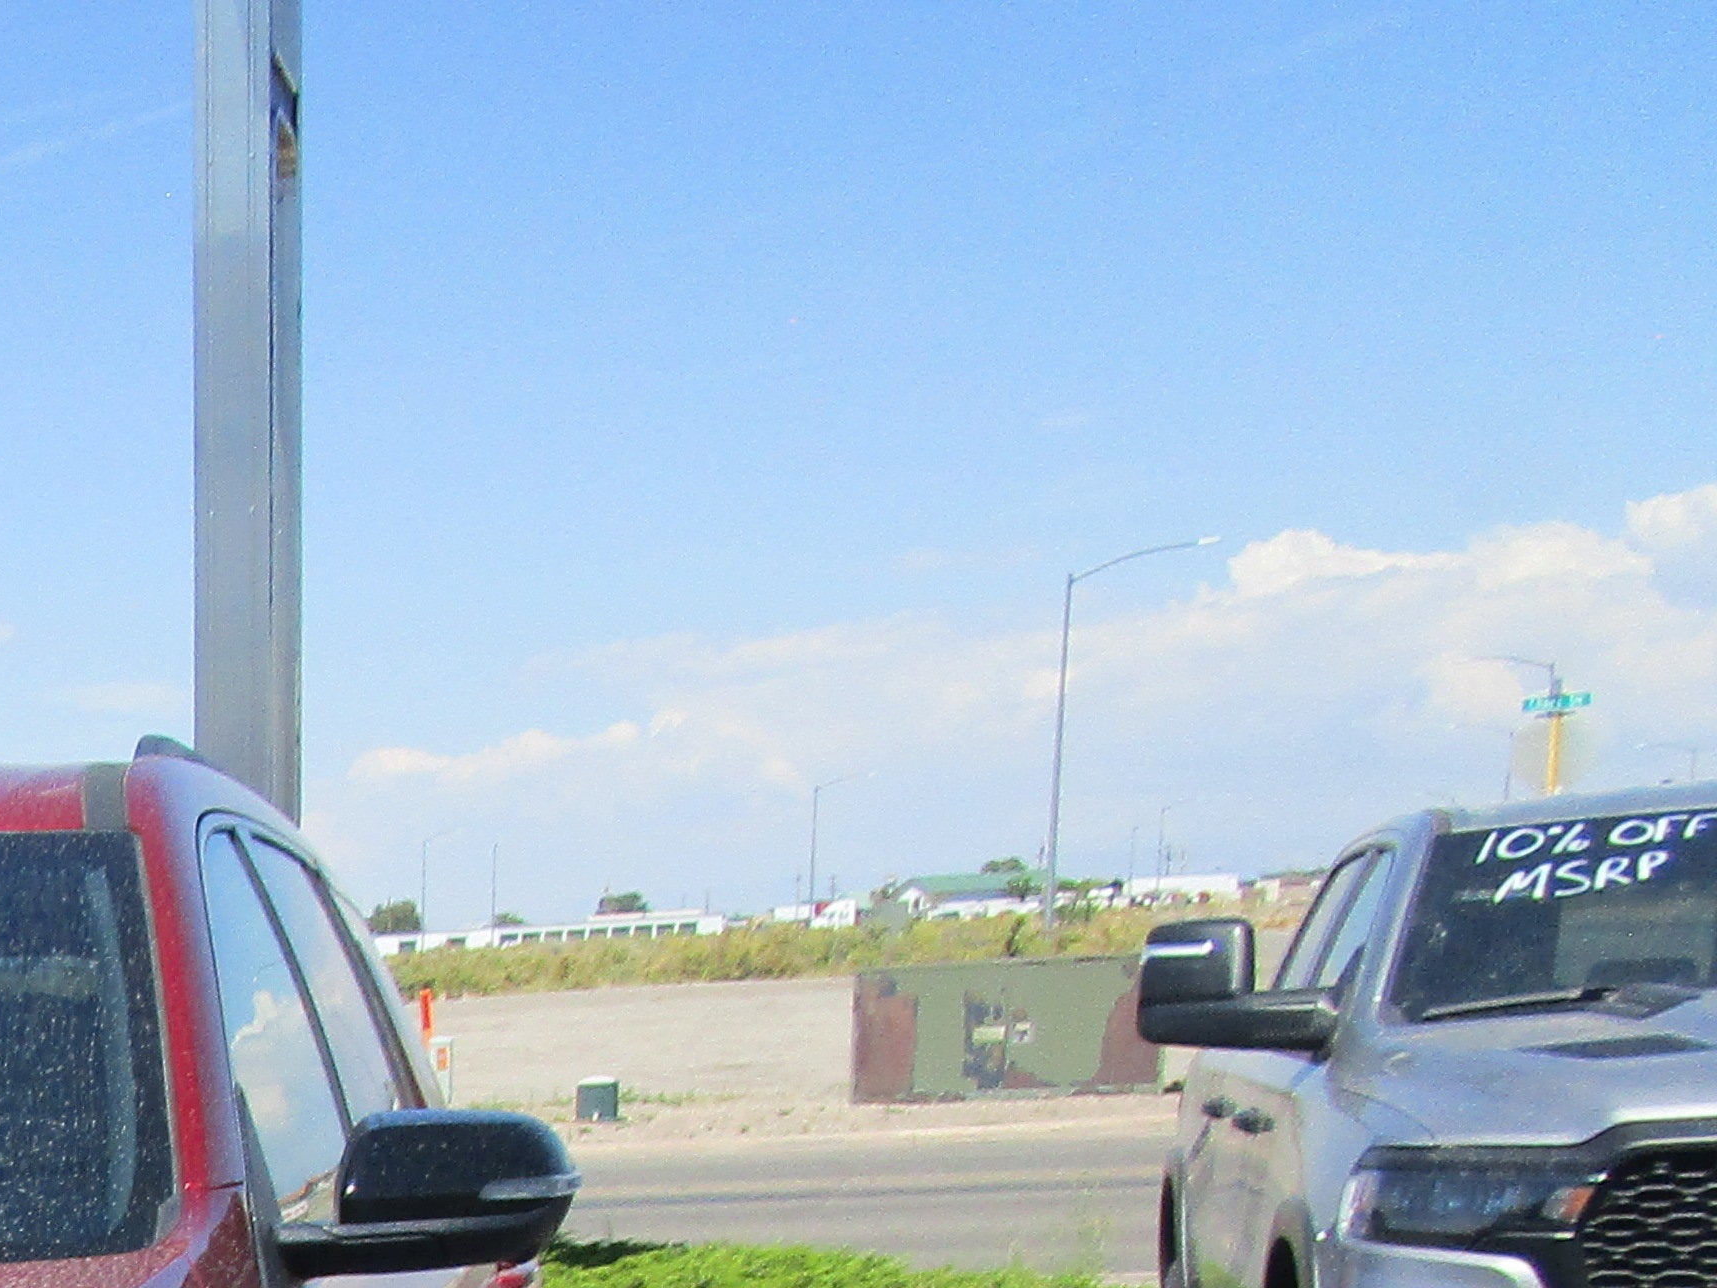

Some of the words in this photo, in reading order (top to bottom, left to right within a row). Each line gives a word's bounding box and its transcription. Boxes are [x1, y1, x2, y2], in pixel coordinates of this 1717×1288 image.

[1475, 823, 1590, 864] 10%
[1609, 814, 1717, 845] OFF
[1494, 850, 1669, 905] MSRP
